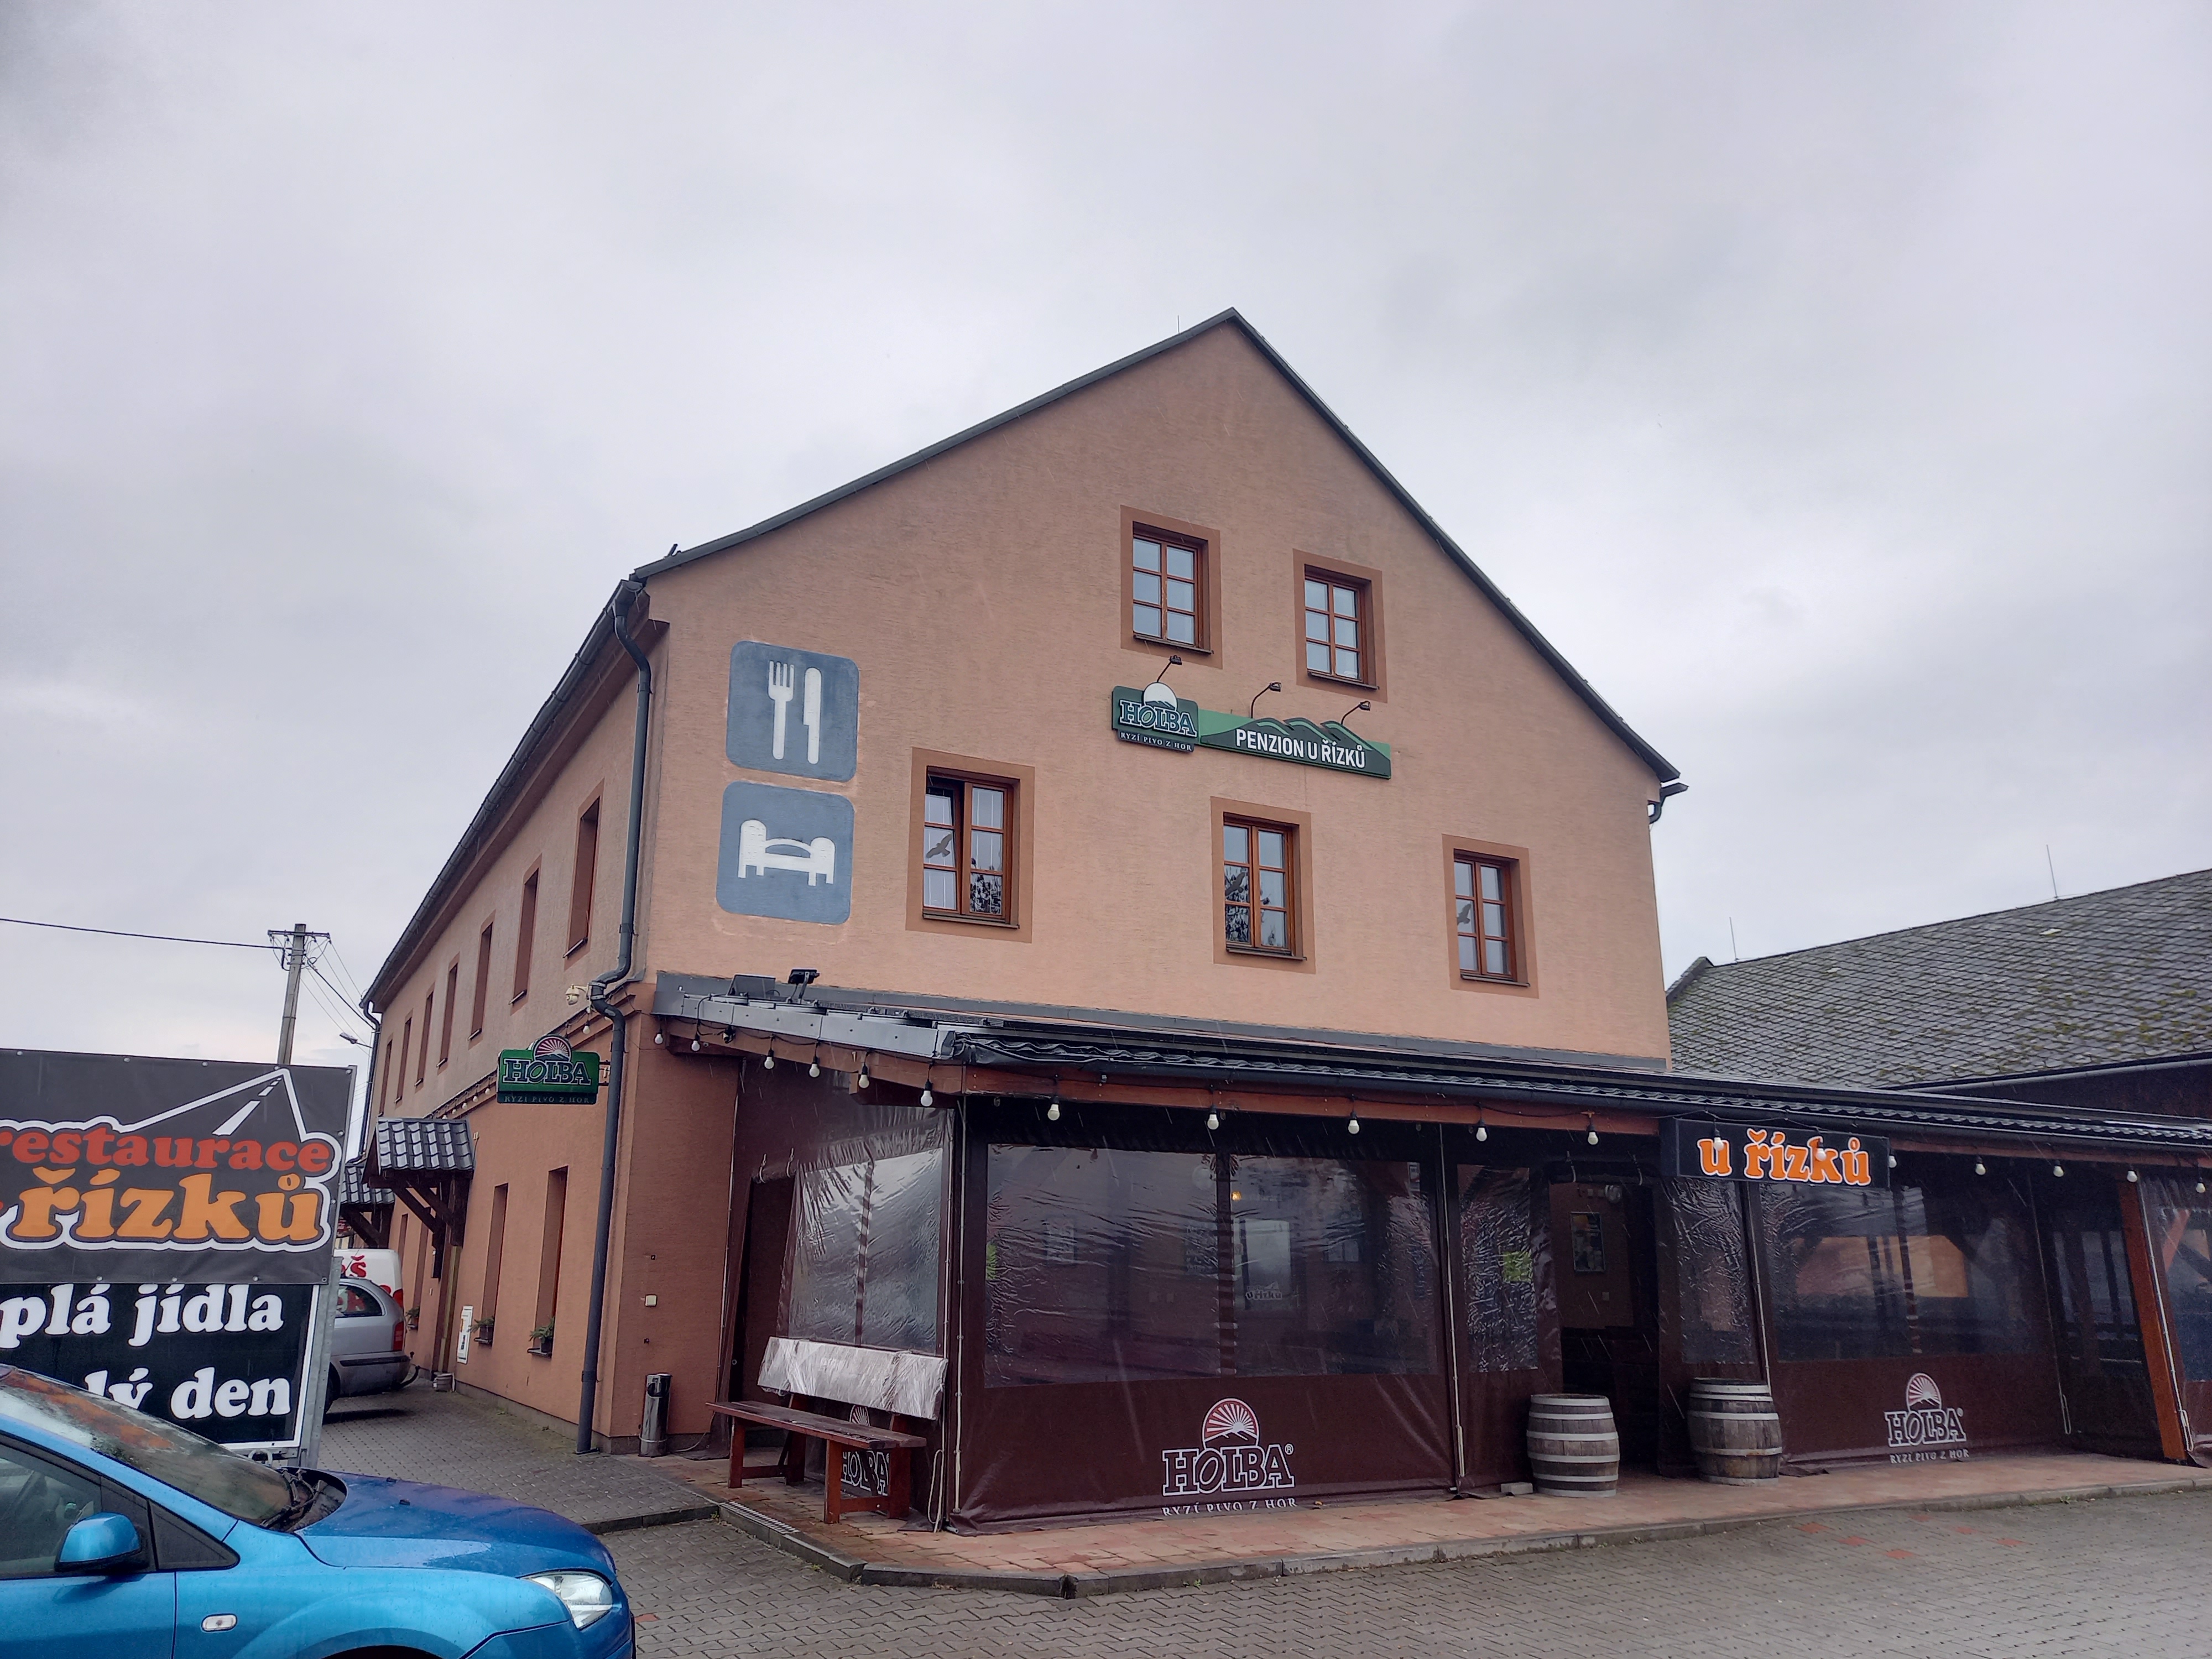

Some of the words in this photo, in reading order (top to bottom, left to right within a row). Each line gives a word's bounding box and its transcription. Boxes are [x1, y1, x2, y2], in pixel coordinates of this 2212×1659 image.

[1119, 700, 1197, 737] HOLBA
[1144, 737, 1162, 745] PIVO
[1174, 743, 1192, 751] HOR
[1236, 729, 1303, 758] PENZION
[1308, 742, 1318, 760] U
[1322, 739, 1365, 768] ŘÍZKŮ
[503, 1058, 592, 1085] HOLBA
[1697, 1138, 1732, 1176] u
[1744, 1128, 1871, 1186] řízků
[12, 1166, 319, 1241] řízků
[128, 1284, 284, 1347] jídla
[170, 1367, 291, 1419] den
[1884, 1408, 1966, 1447] HOLBA
[1162, 1444, 1295, 1496] HOLBA
[1206, 1501, 1243, 1512] PIVO
[1249, 1500, 1259, 1510] Z
[1265, 1498, 1297, 1509] HOR
